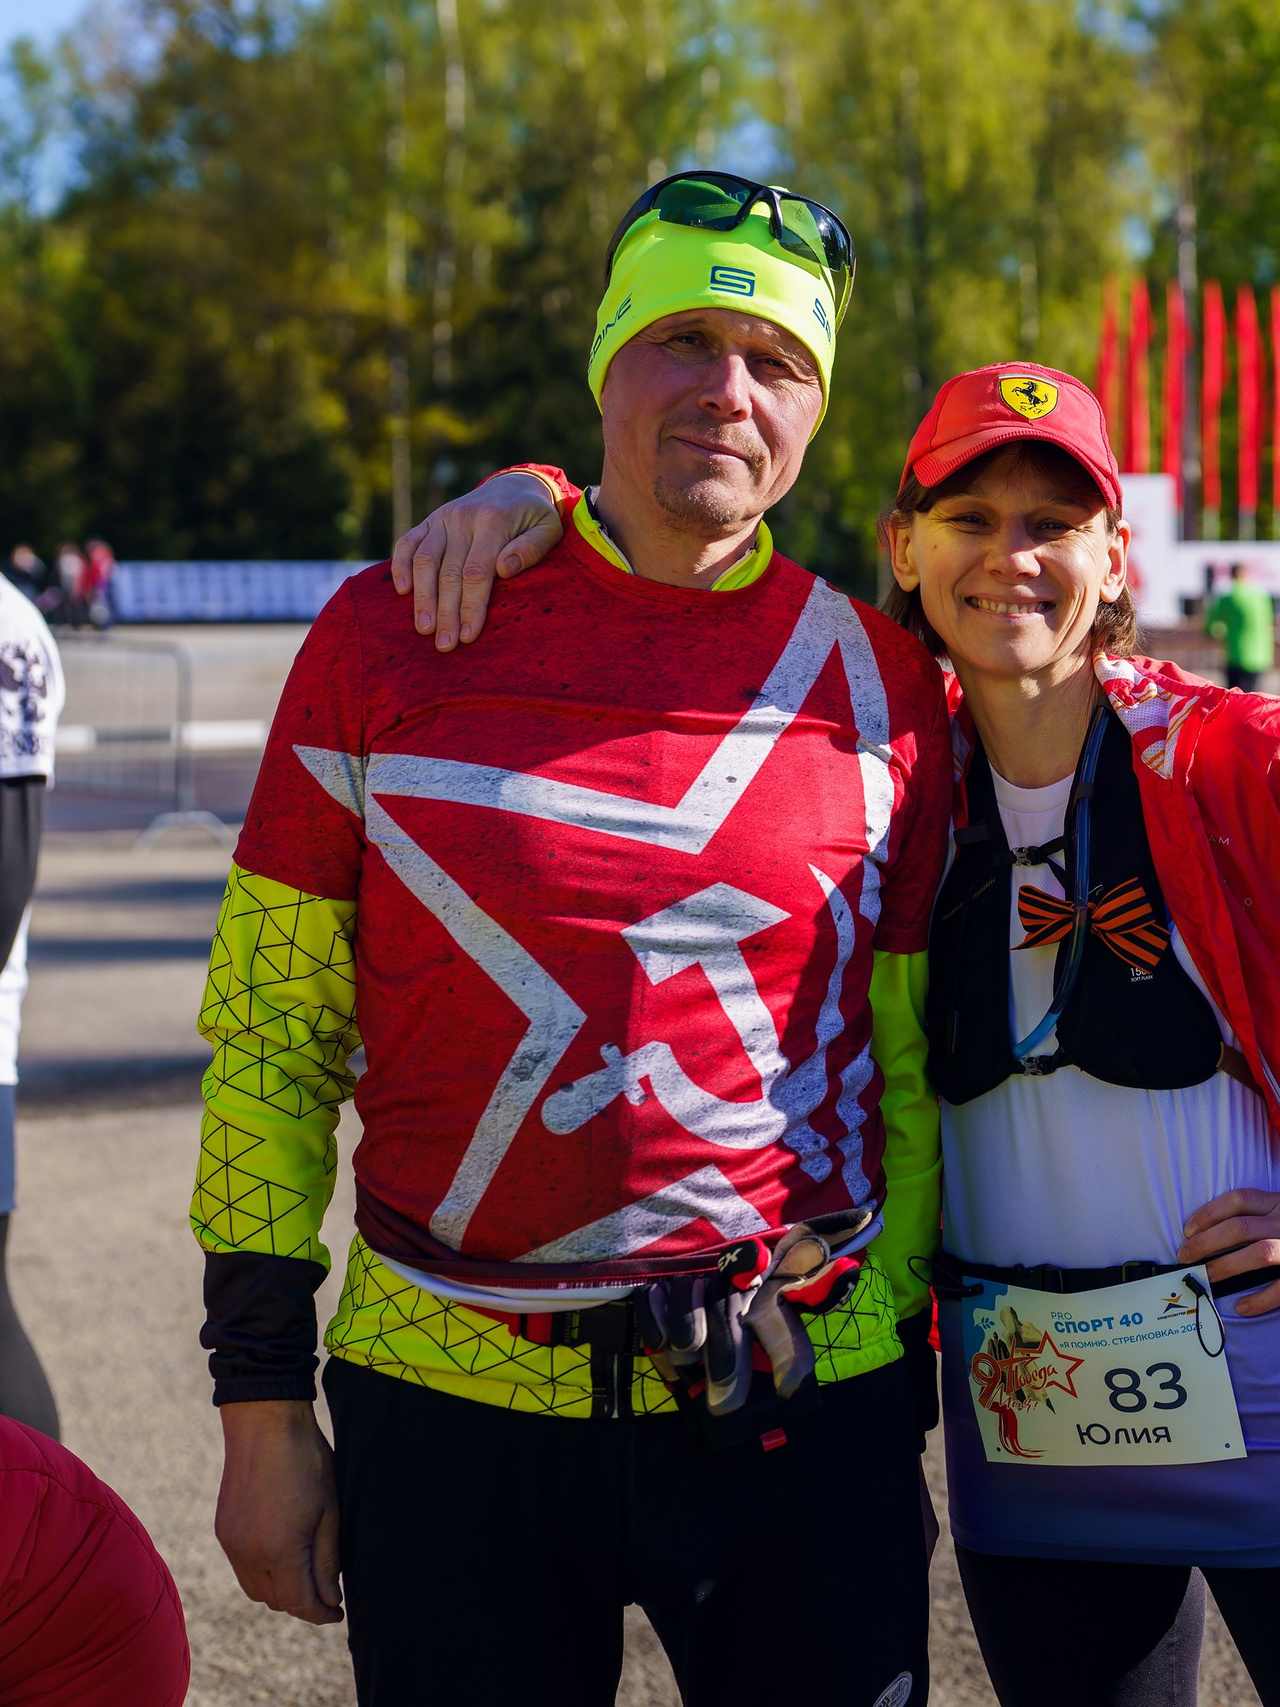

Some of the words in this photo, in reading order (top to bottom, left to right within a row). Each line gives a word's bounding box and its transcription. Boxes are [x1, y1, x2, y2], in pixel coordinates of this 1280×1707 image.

[1050, 1311, 1072, 1321] PRO
[1053, 1316, 1114, 1334] СПОРТ
[1119, 1312, 1144, 1327] 40
[1059, 1341, 1070, 1349] «Я
[1071, 1340, 1111, 1349] ПОМНЮ.
[1112, 1328, 1179, 1346] СТРЕЛКОВКА»
[1181, 1321, 1204, 1334] 2025
[1104, 1362, 1188, 1413] 83
[1076, 1423, 1173, 1446] Юлия
